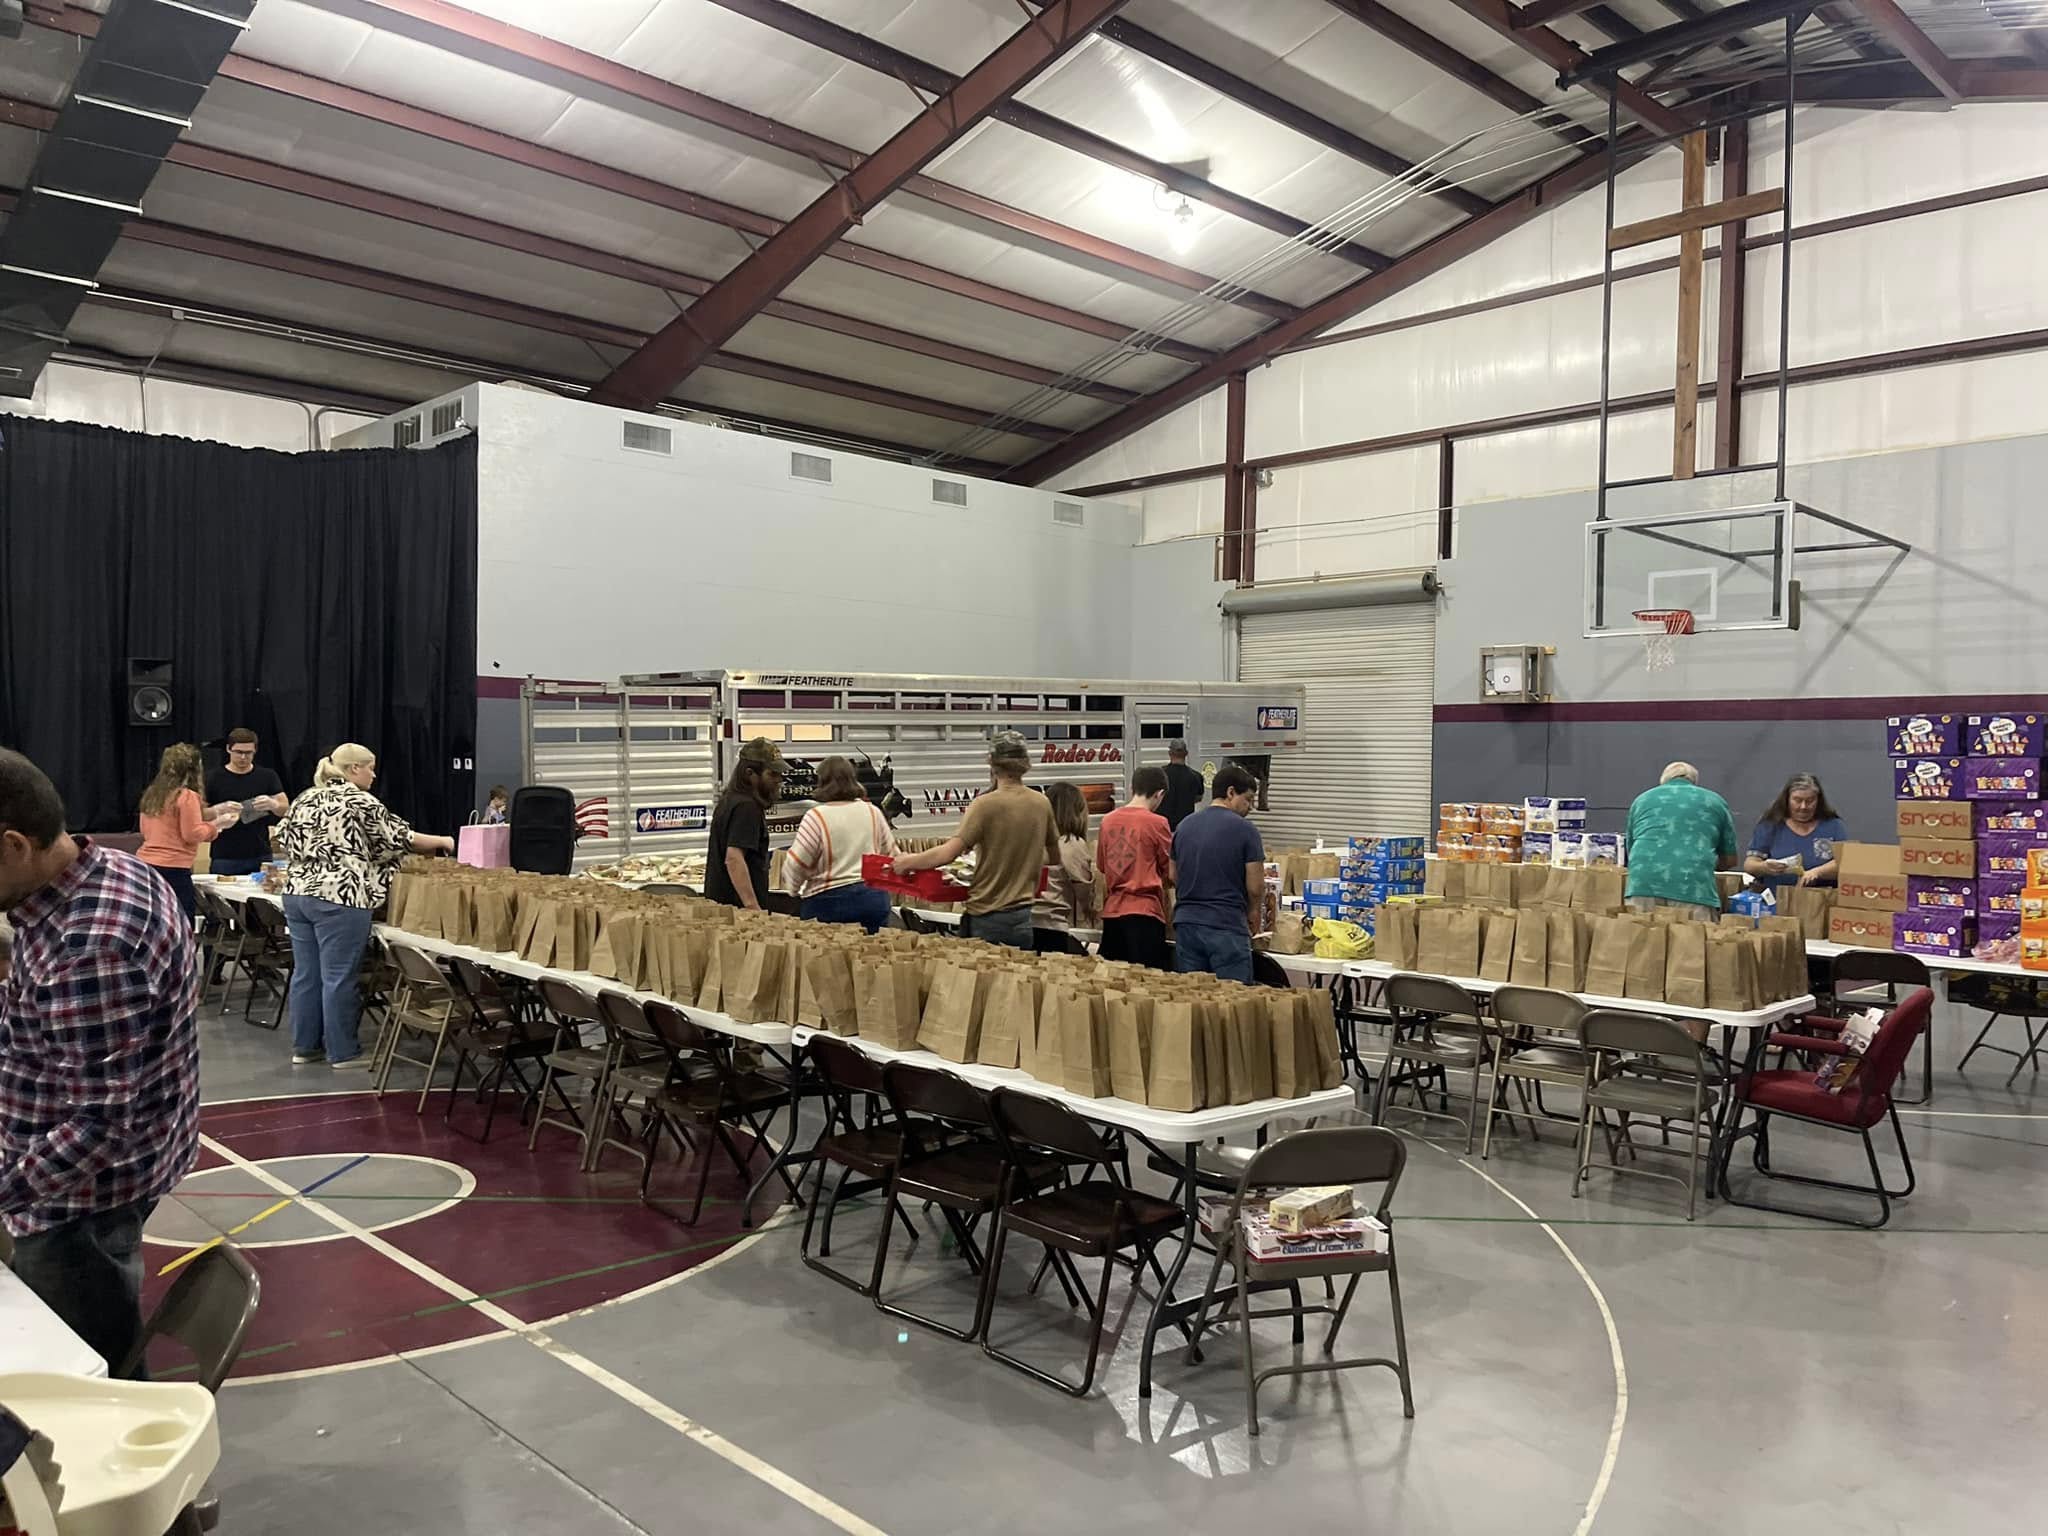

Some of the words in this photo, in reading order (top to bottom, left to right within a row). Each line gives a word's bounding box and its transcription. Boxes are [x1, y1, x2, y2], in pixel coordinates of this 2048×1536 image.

[788, 675, 855, 687] FEATHERLITE
[1041, 743, 1096, 763] Rodeo
[1098, 743, 1121, 762] Co.
[655, 808, 705, 822] FEATHERLITE
